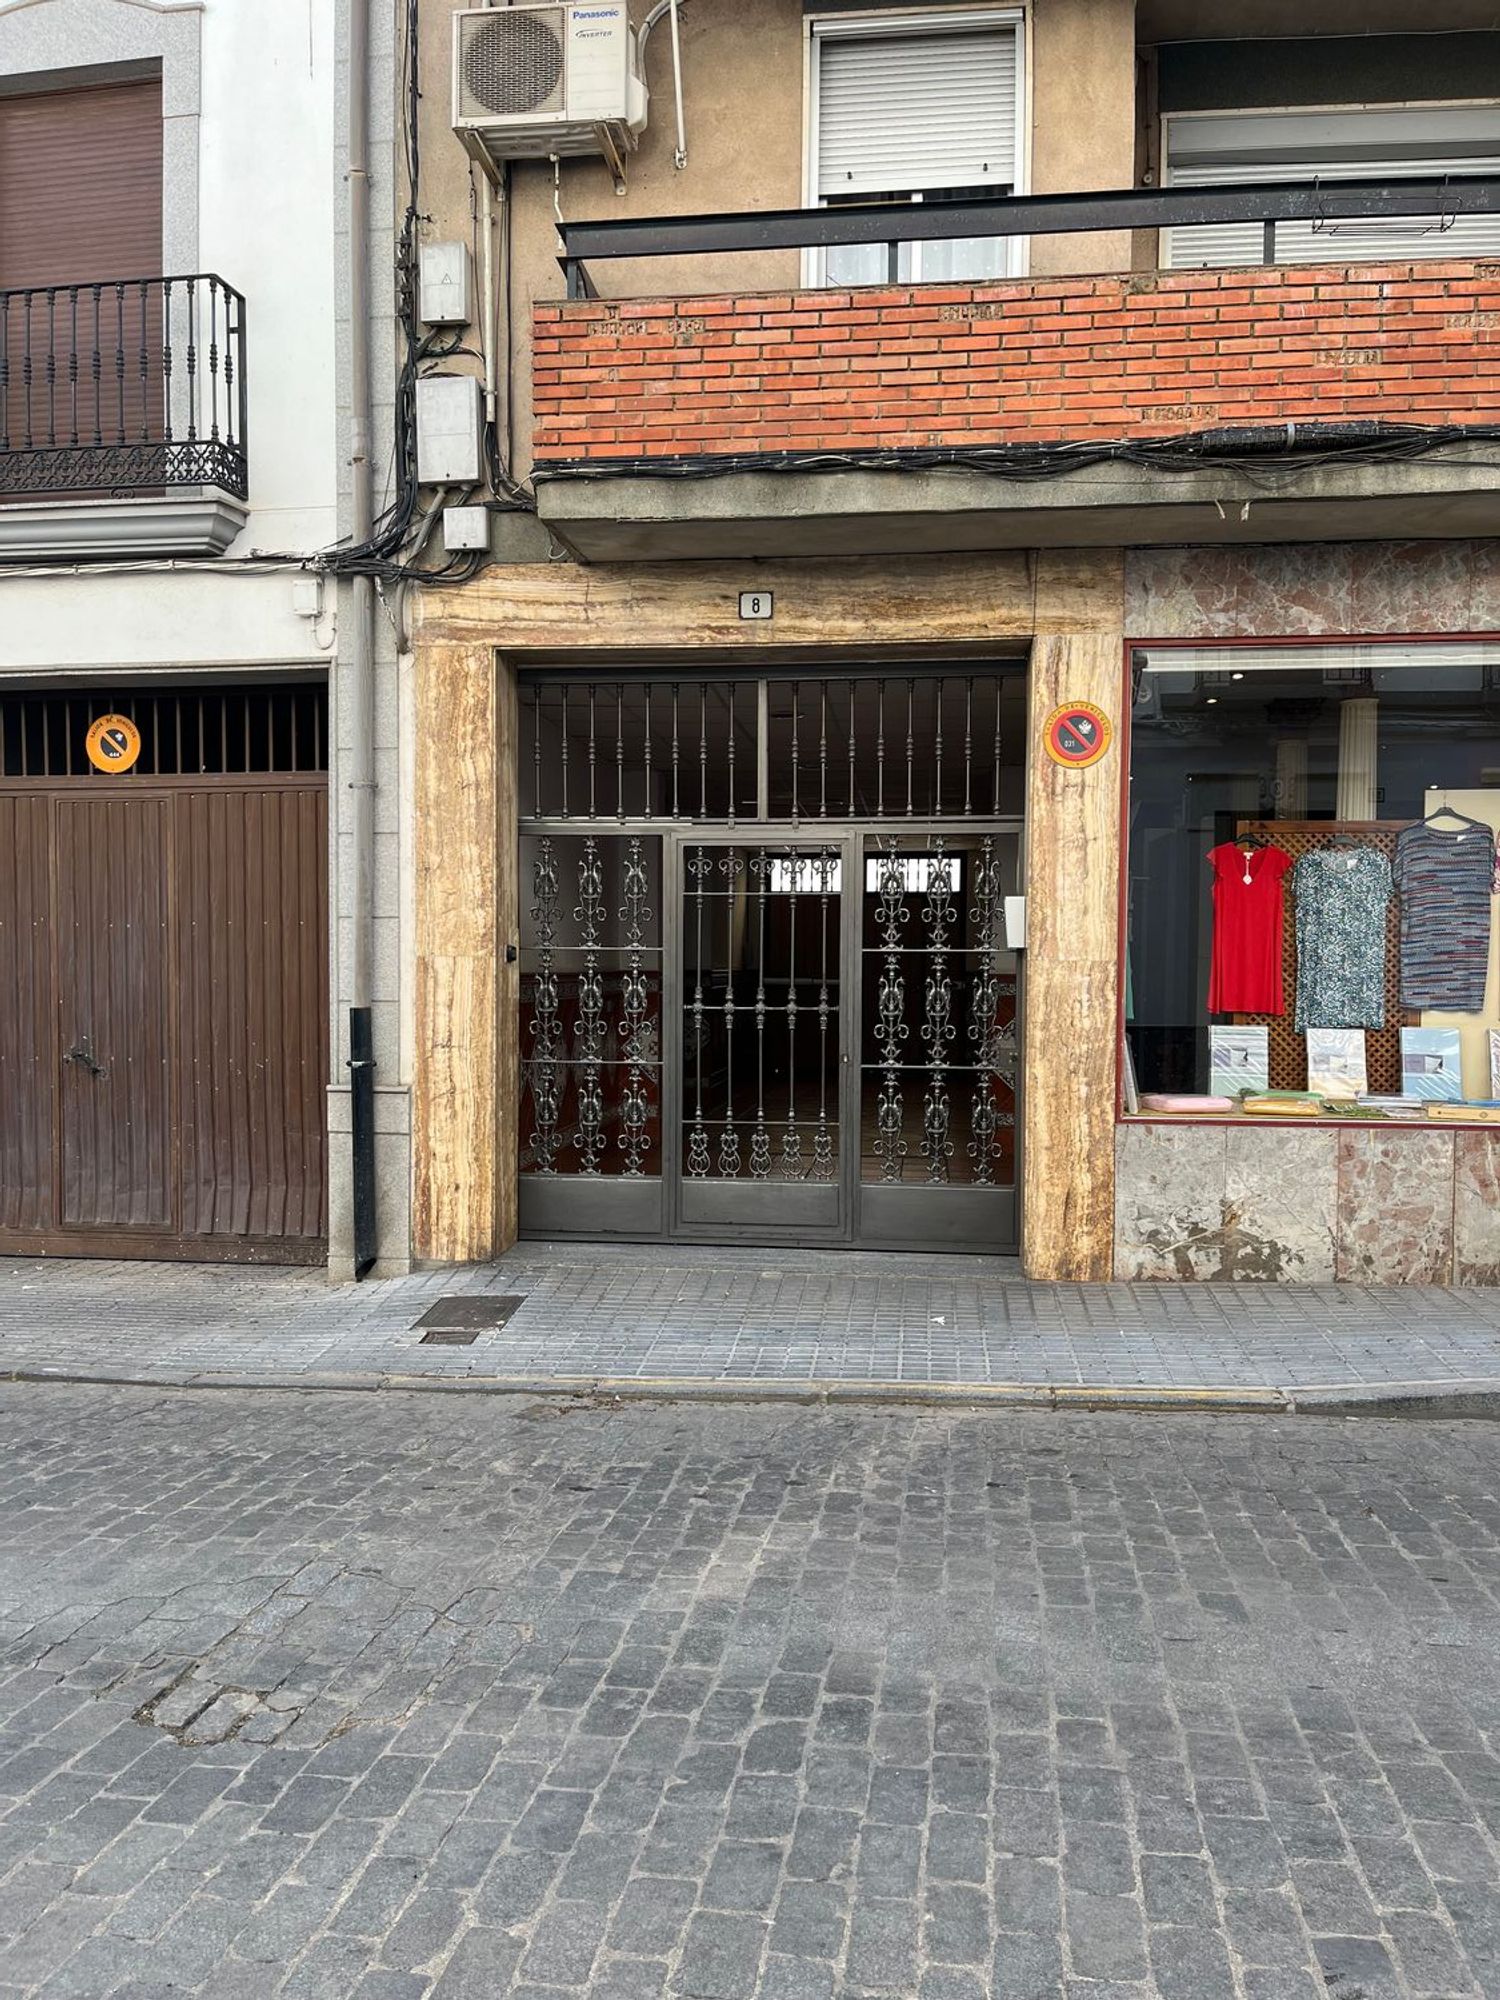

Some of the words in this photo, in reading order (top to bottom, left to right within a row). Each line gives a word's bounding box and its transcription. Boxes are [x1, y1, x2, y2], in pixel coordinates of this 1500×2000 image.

[573, 10, 619, 19] Panasonic
[579, 30, 612, 38] INVERTER
[751, 597, 760, 614] 8
